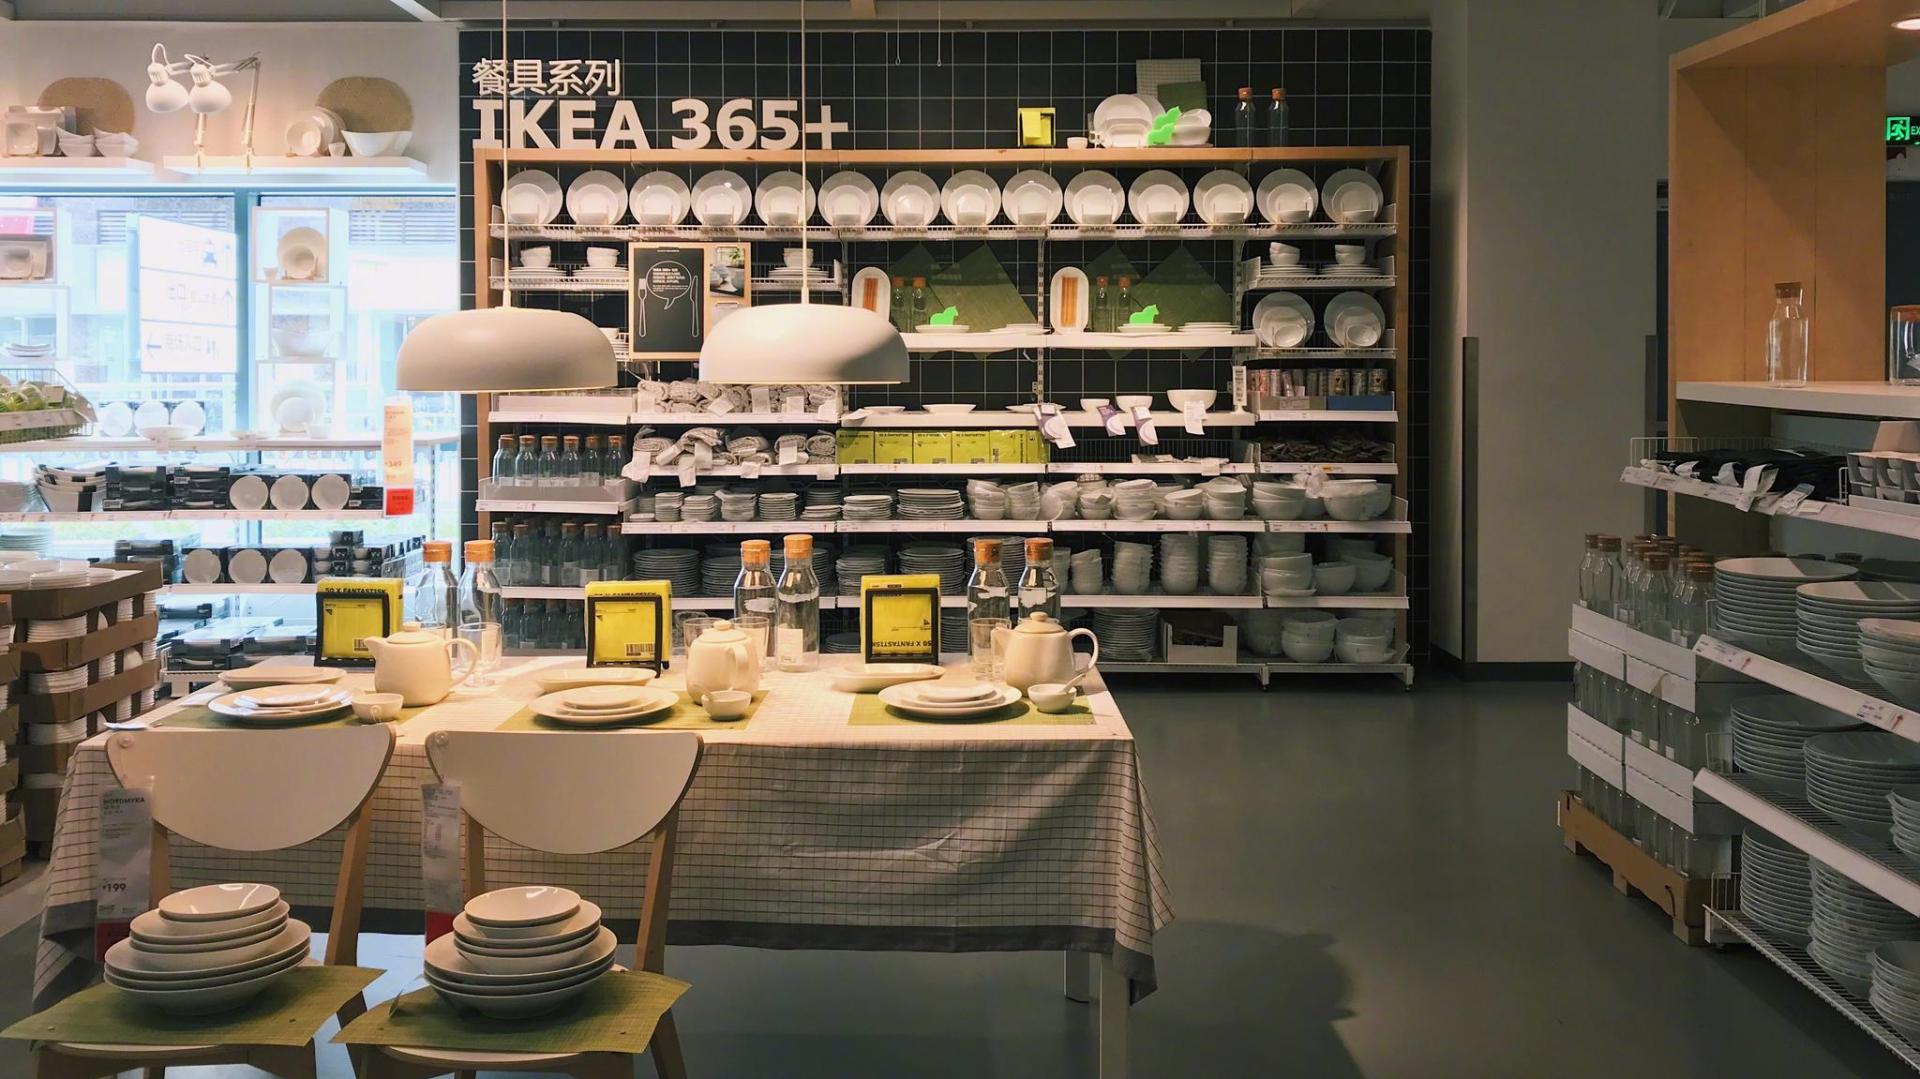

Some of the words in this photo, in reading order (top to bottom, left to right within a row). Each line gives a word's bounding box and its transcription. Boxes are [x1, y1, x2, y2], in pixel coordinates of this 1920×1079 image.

[472, 58, 621, 97] 餐具系列
[472, 100, 650, 150] IKEA
[670, 98, 849, 150] 365+
